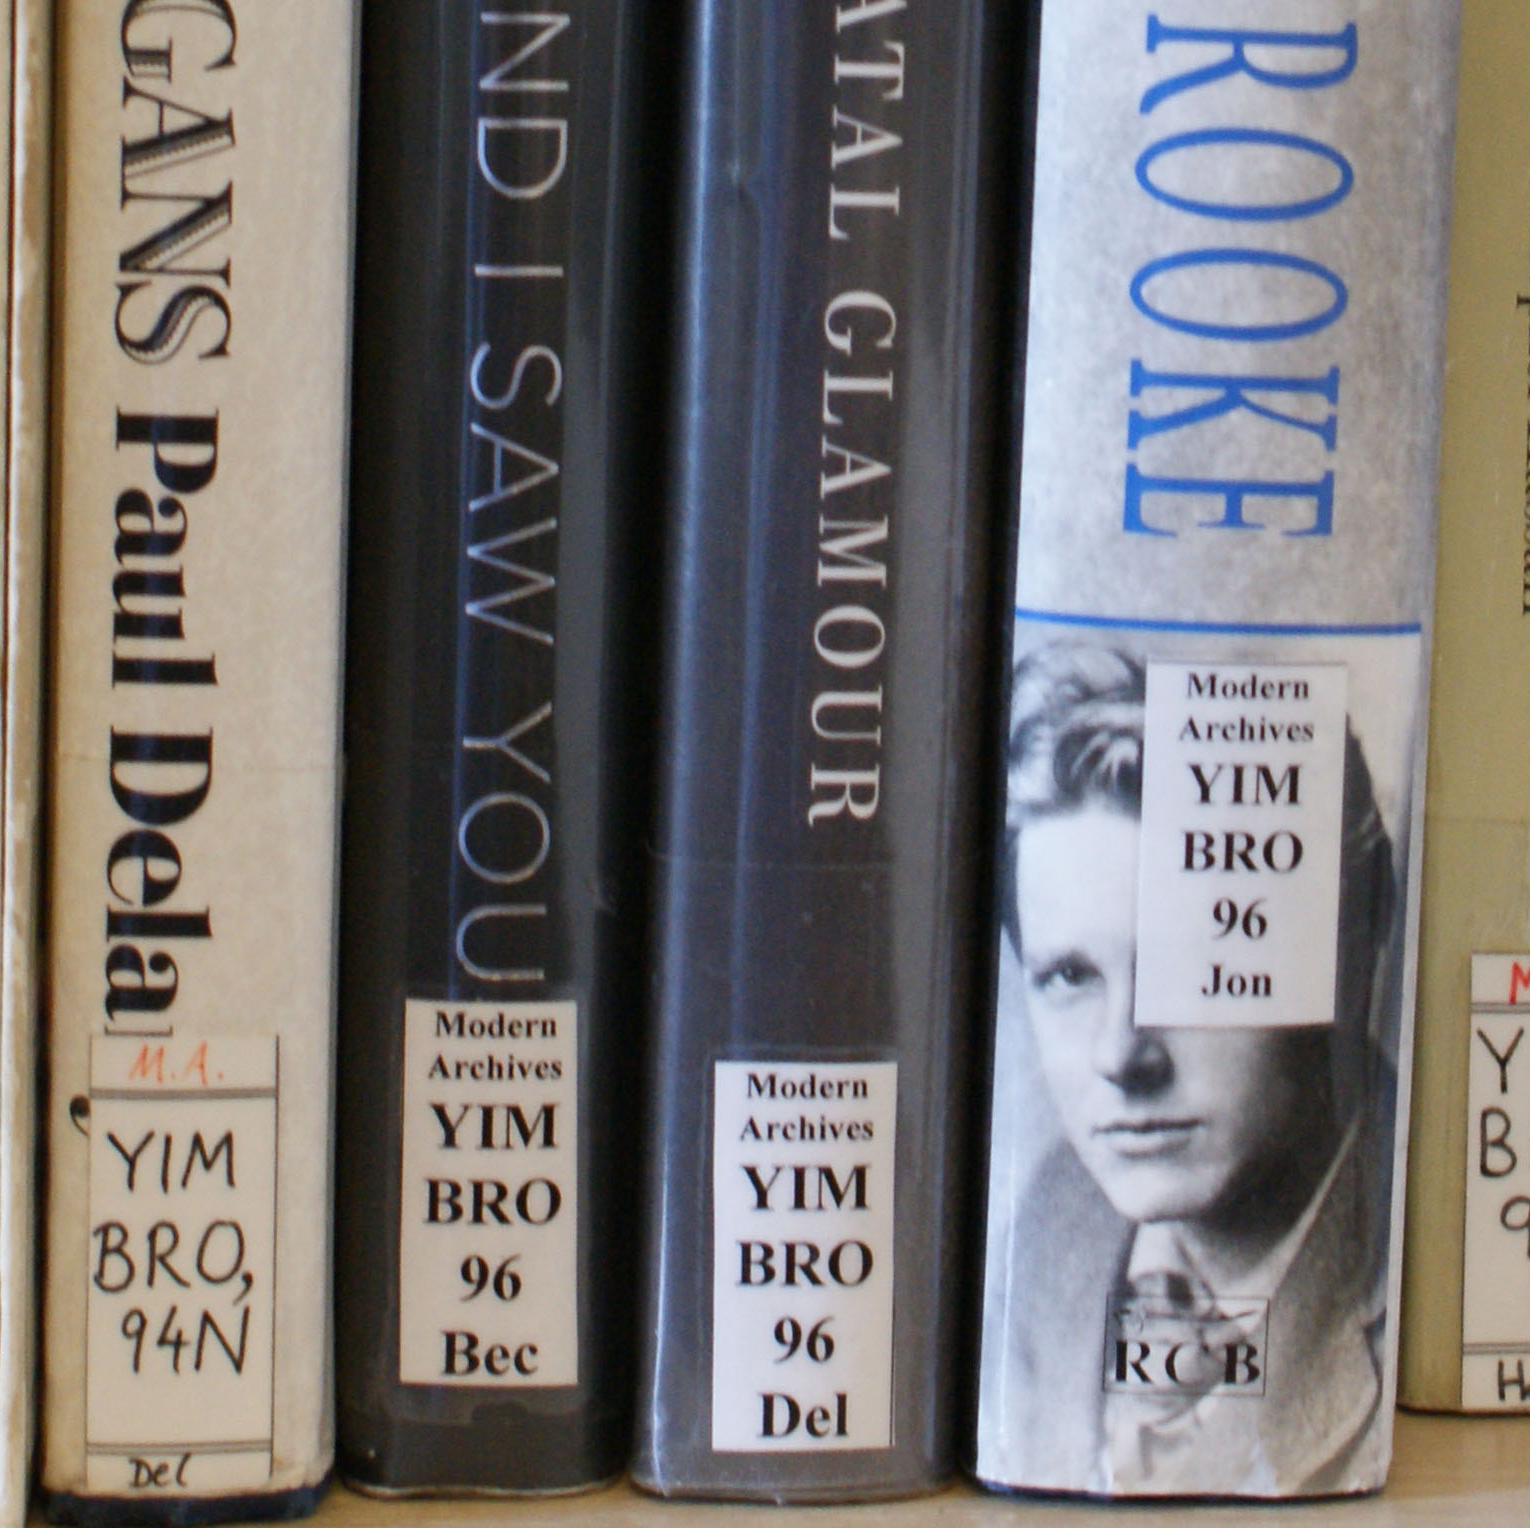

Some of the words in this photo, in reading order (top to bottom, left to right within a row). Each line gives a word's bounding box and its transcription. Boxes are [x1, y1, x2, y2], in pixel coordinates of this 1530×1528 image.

[472, 262, 566, 280] I
[465, 341, 564, 647] SAW
[110, 404, 221, 690] Paul
[807, 288, 899, 830] GLAMOUR
[1185, 671, 1311, 701] Modern
[1177, 716, 1316, 744] Archives
[1187, 761, 1303, 807] YIM
[455, 700, 553, 984] YOU
[1179, 828, 1305, 874] BRO
[1210, 897, 1270, 941] 96
[1200, 962, 1273, 999] Jon
[435, 1010, 559, 1040] Modern
[427, 1053, 565, 1082] Archives
[746, 1071, 871, 1101] Modern
[429, 1102, 560, 1152] YIM
[738, 1115, 876, 1143] Archives
[106, 1129, 237, 1196] YIM
[423, 1176, 564, 1226] BRO
[740, 1163, 872, 1213] YIM
[92, 1218, 255, 1307] BRO,
[458, 1252, 524, 1304] 96
[734, 1238, 876, 1288] BRO
[120, 1304, 252, 1376] 94N
[439, 1329, 541, 1377] Bec
[772, 1315, 837, 1365] 96
[756, 1391, 851, 1439] Del
